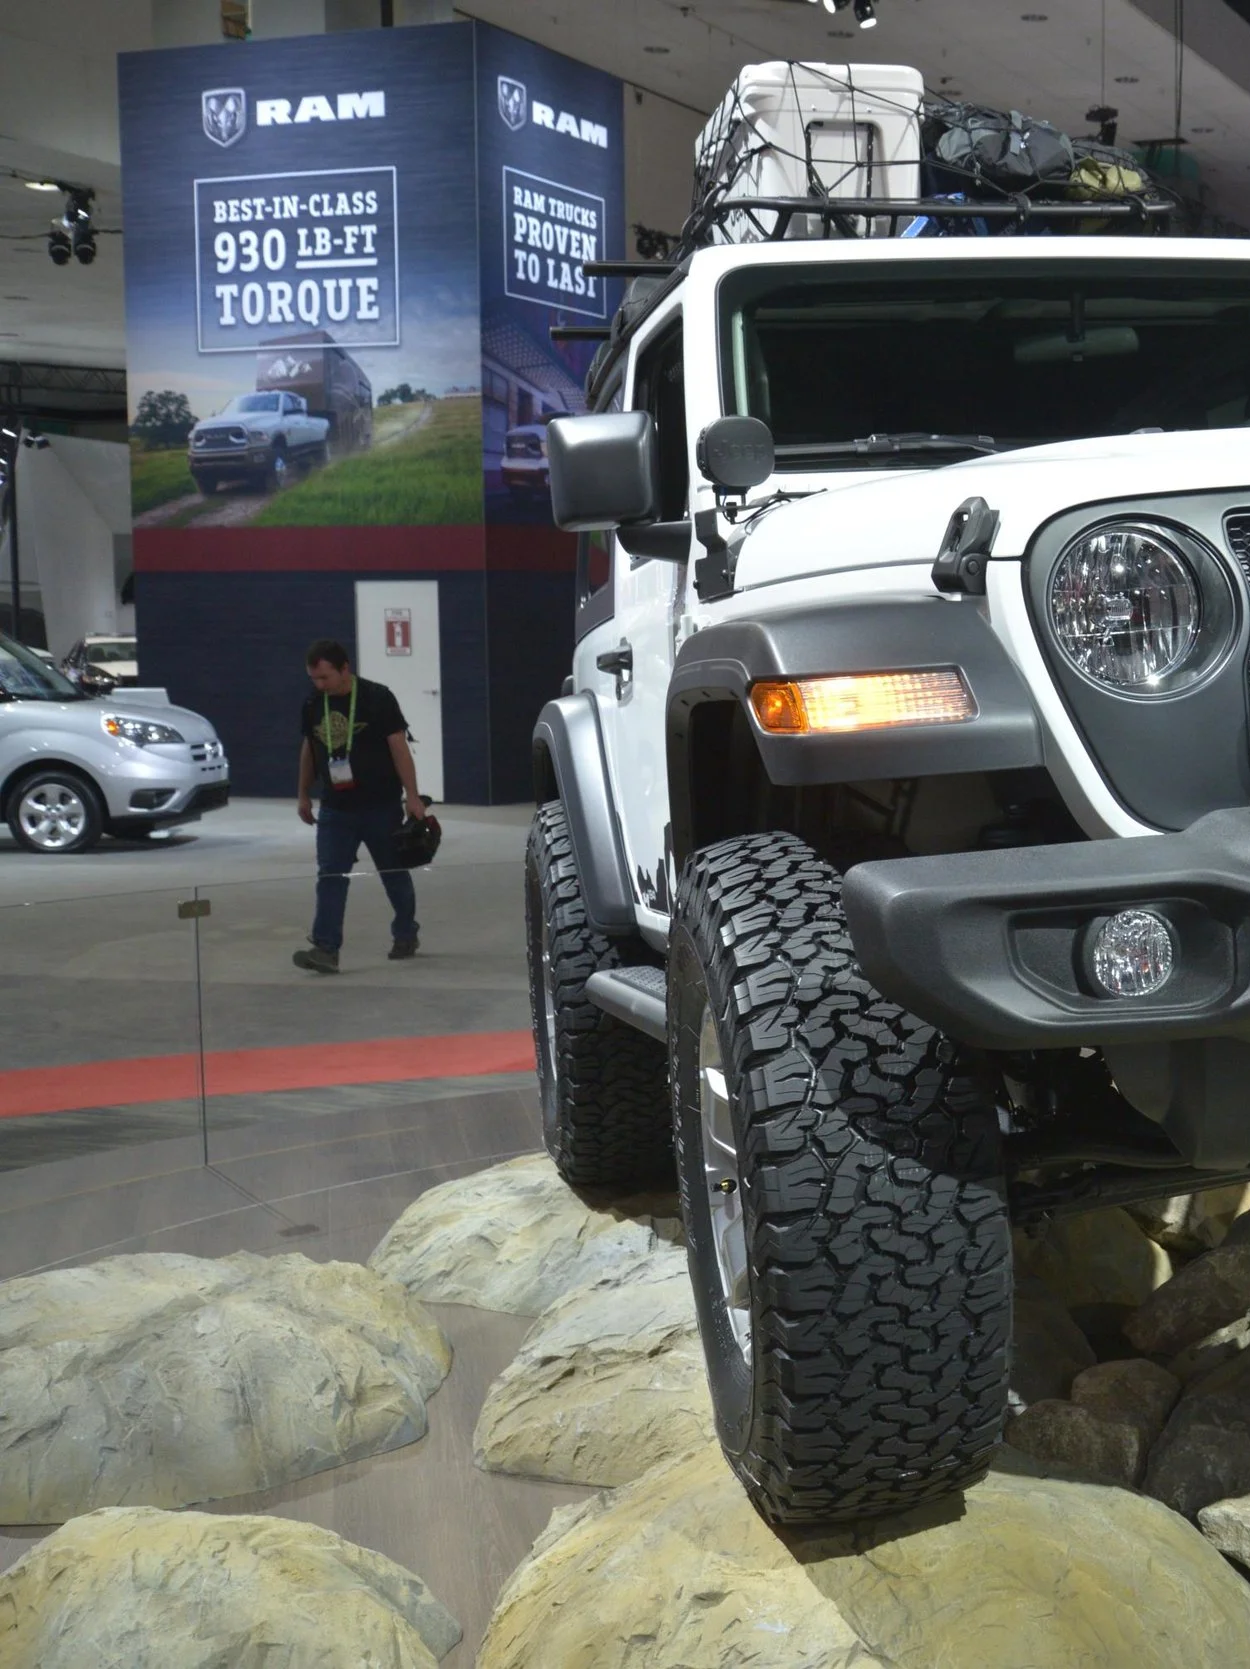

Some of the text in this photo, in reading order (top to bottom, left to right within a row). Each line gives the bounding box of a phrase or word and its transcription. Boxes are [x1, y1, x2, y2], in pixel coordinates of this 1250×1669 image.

[256, 90, 386, 127] RAM
[531, 100, 608, 149] RAM
[213, 190, 378, 224] BEST-IN-CLASS
[513, 185, 598, 230] RAM TRUCKS
[213, 224, 378, 274] 930 LB-FT
[513, 211, 598, 264] PROVEN
[514, 248, 597, 299] TO LAST
[214, 276, 380, 327] TORQUE
